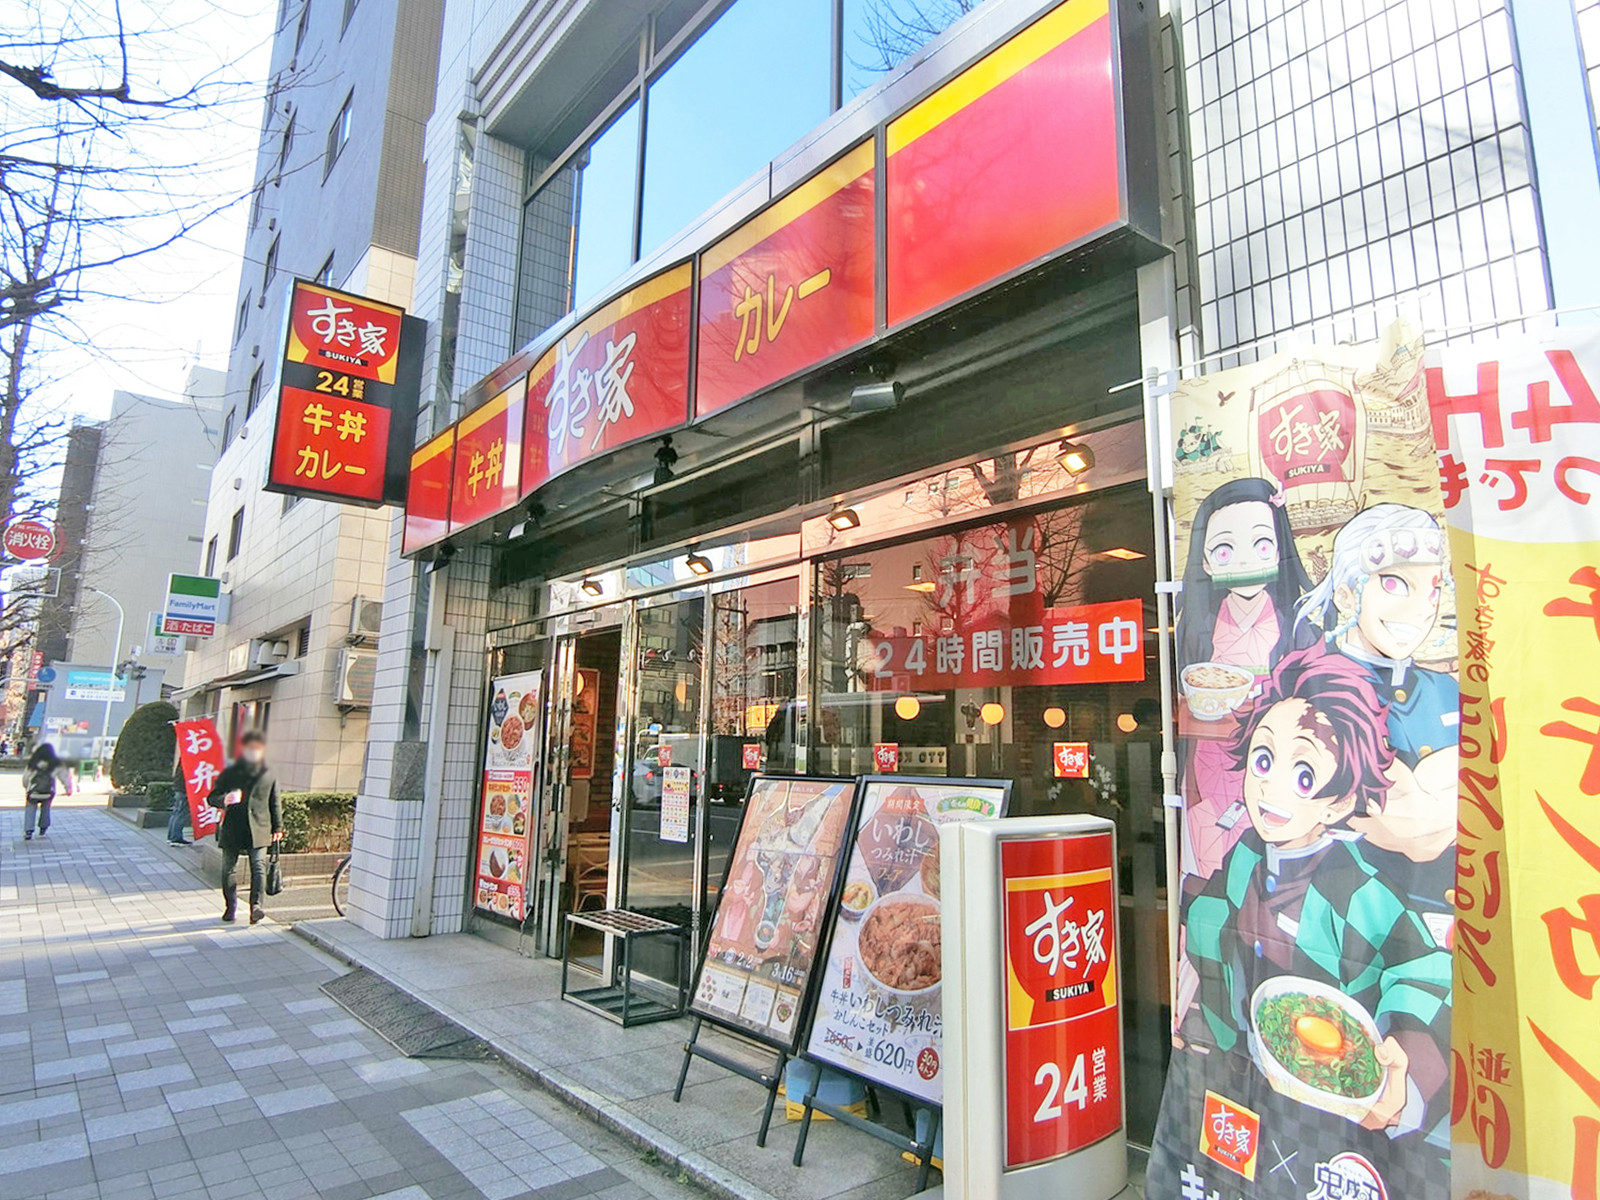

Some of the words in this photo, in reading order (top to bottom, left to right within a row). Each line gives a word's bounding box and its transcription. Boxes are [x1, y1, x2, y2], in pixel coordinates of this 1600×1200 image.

[307, 297, 388, 357] すき家
[734, 267, 831, 362] カレー
[325, 351, 362, 366] SUKIYA
[316, 371, 350, 396] 24
[352, 378, 365, 400] 営業
[544, 331, 637, 454] すき家
[303, 403, 367, 443] 牛丼
[1269, 404, 1345, 462] すき家
[295, 445, 366, 480] カレー
[467, 437, 503, 497] 牛丼
[1288, 464, 1324, 478] SUKIYA
[8, 531, 51, 550] 消火栓
[940, 526, 1037, 608] 弁当
[169, 600, 215, 611] FamilyMart
[874, 616, 1138, 678] 24時間販売中
[186, 729, 220, 828] お弁当
[872, 818, 930, 849] いわし
[871, 847, 918, 865] つみれ汁
[1025, 891, 1106, 978] すき家
[1053, 982, 1090, 1000] SUKIYA
[833, 1009, 888, 1037] おしんこセット
[874, 1040, 914, 1074] 620円
[1034, 1053, 1088, 1122] 24
[1092, 1046, 1107, 1103] 営業
[1211, 1104, 1251, 1155] すき家
